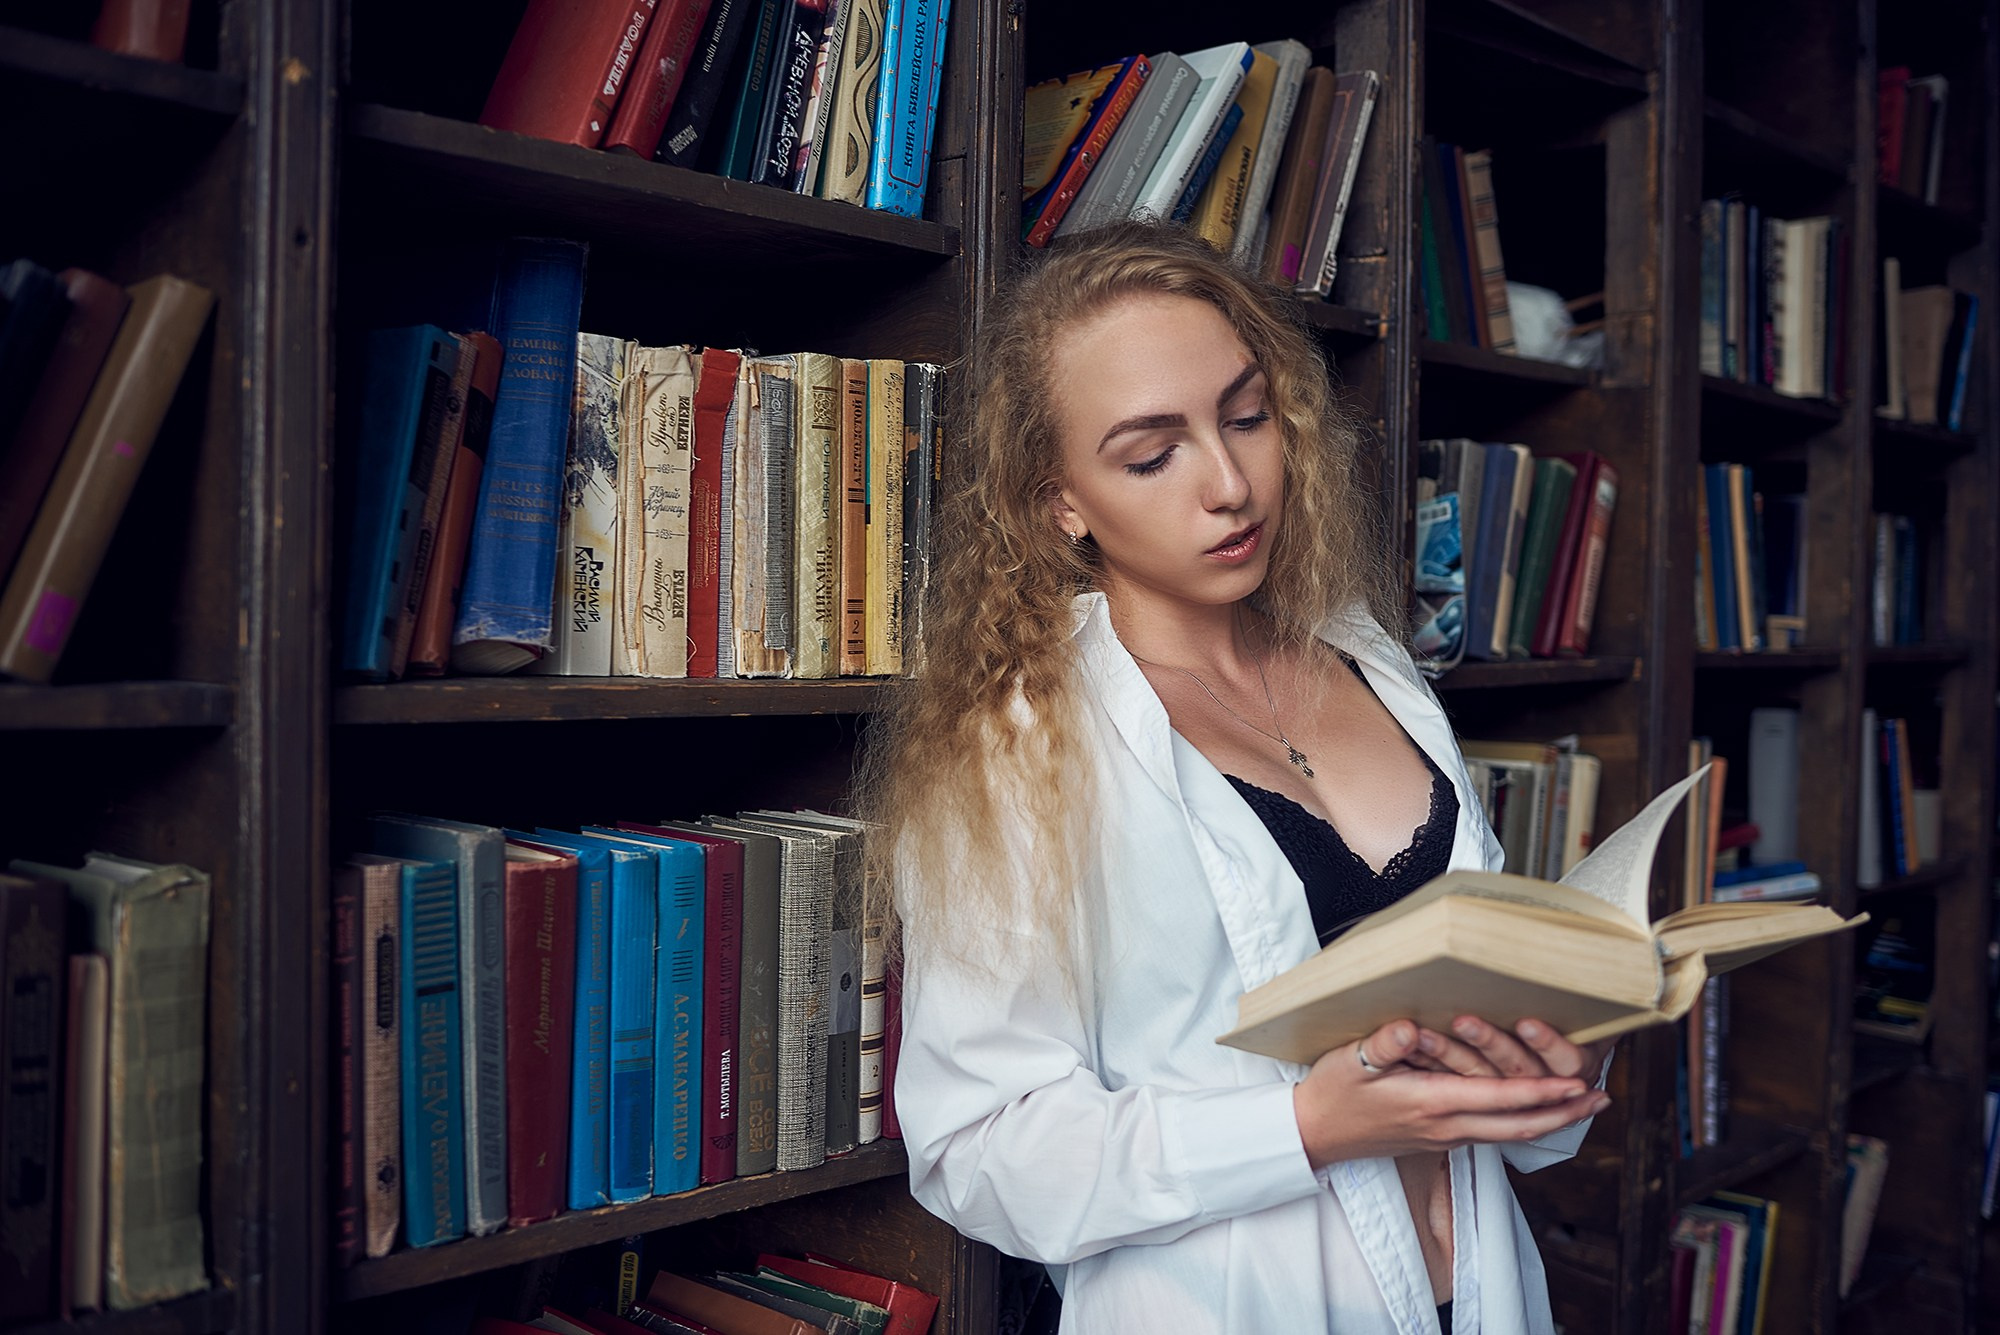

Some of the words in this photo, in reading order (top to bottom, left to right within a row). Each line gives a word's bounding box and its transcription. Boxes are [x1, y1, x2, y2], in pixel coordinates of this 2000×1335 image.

[602, 11, 645, 96] РОДИНА
[702, 43, 718, 72] проза
[908, 19, 925, 116] БИБЛЕЙСКИХ
[817, 89, 832, 128] Поляна
[811, 129, 824, 160] Ясная
[904, 120, 916, 166] КНИГА
[650, 393, 668, 454] Привет
[677, 396, 690, 450] ВЕРНЕРА
[852, 399, 864, 485] А.К.ТОЛСТОЙ
[823, 437, 832, 519] ИЗБРАННОЕ
[573, 546, 593, 632] КАМЕНСКИЙ
[642, 558, 665, 632] Володины
[672, 569, 685, 619] БРАТЬЯ
[815, 549, 826, 623] МИХАИЛ
[853, 619, 860, 634] 2
[720, 872, 734, 931] РУБЕЖОМ
[721, 935, 732, 950] ЗА
[672, 993, 689, 1161] А.С.МАКАРЕНКО
[720, 1049, 731, 1119] Т.МОТЫЛЕВА
[872, 1065, 879, 1077] 2
[479, 1060, 503, 1169] ВАЛЕНТИН
[763, 1107, 775, 1150] ОБО
[622, 1253, 635, 1271] ЧУДО
